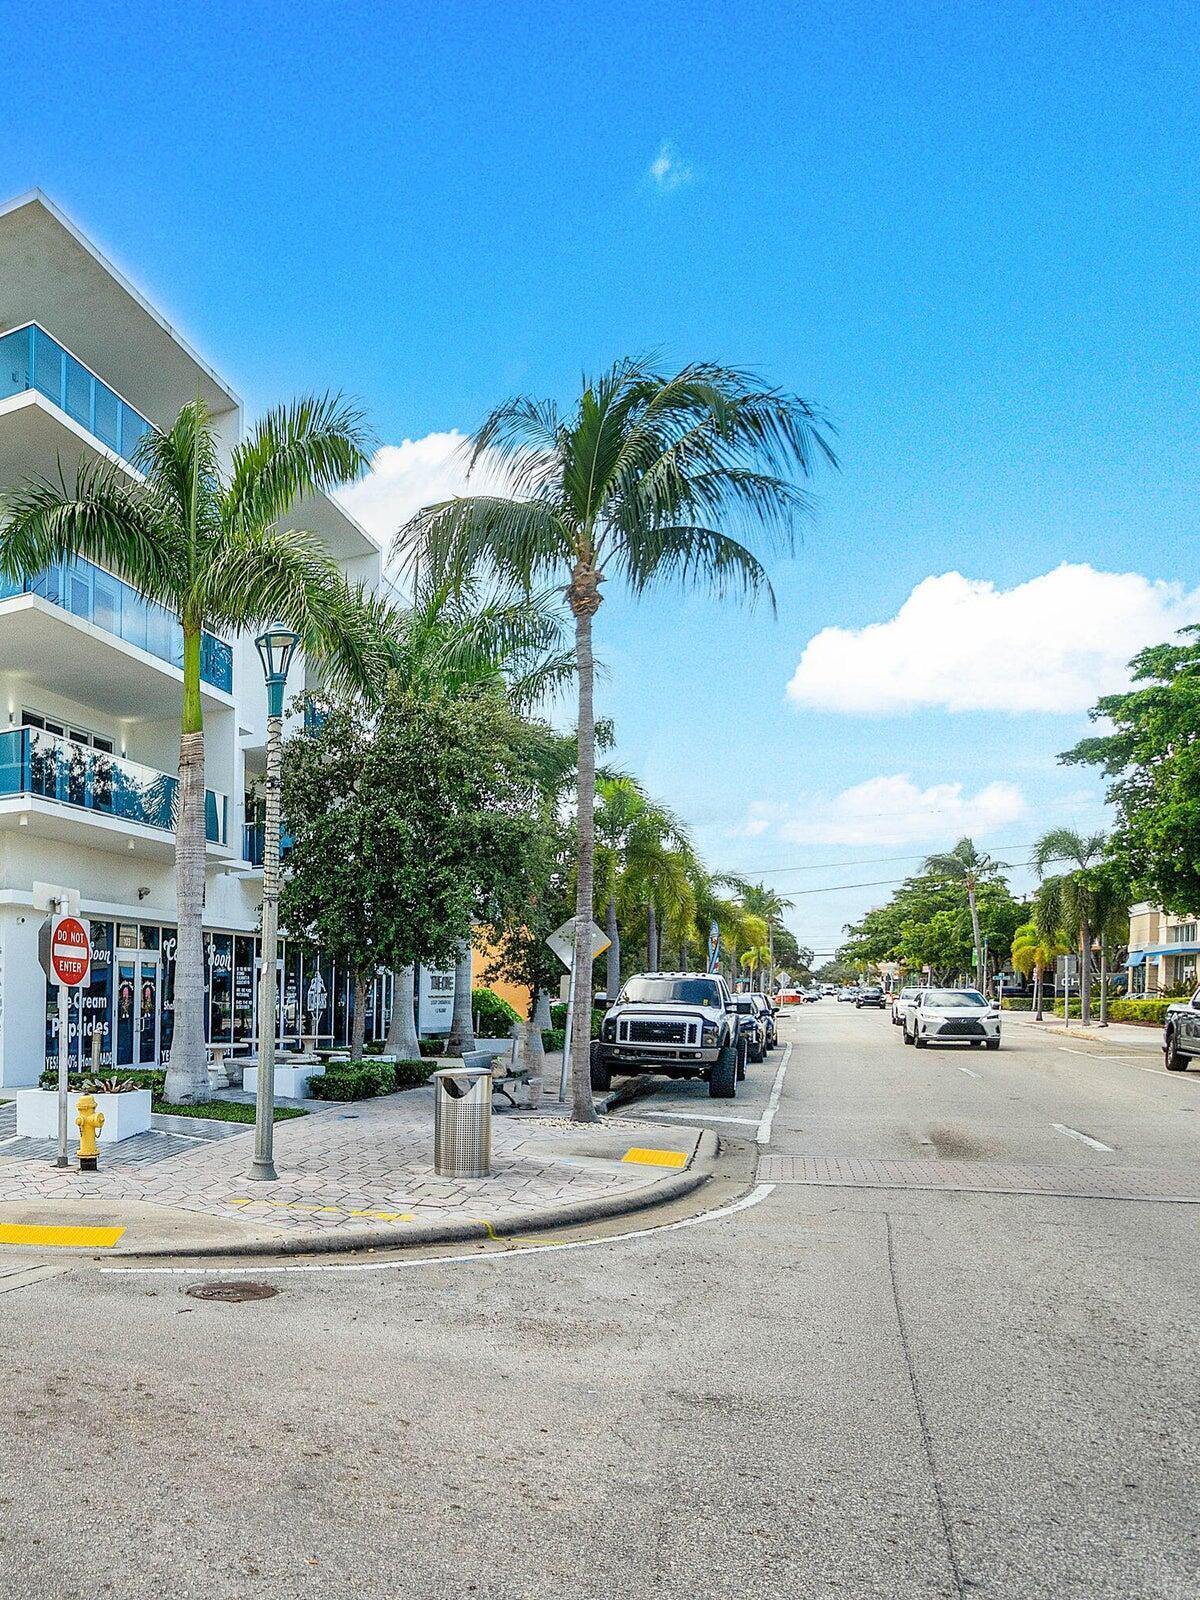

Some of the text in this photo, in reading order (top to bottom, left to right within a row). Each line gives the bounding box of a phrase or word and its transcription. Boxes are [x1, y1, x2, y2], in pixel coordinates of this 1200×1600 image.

[57, 930, 84, 943] DO NOT
[60, 961, 82, 973] ENTER
[51, 1015, 109, 1043] Ppicles
